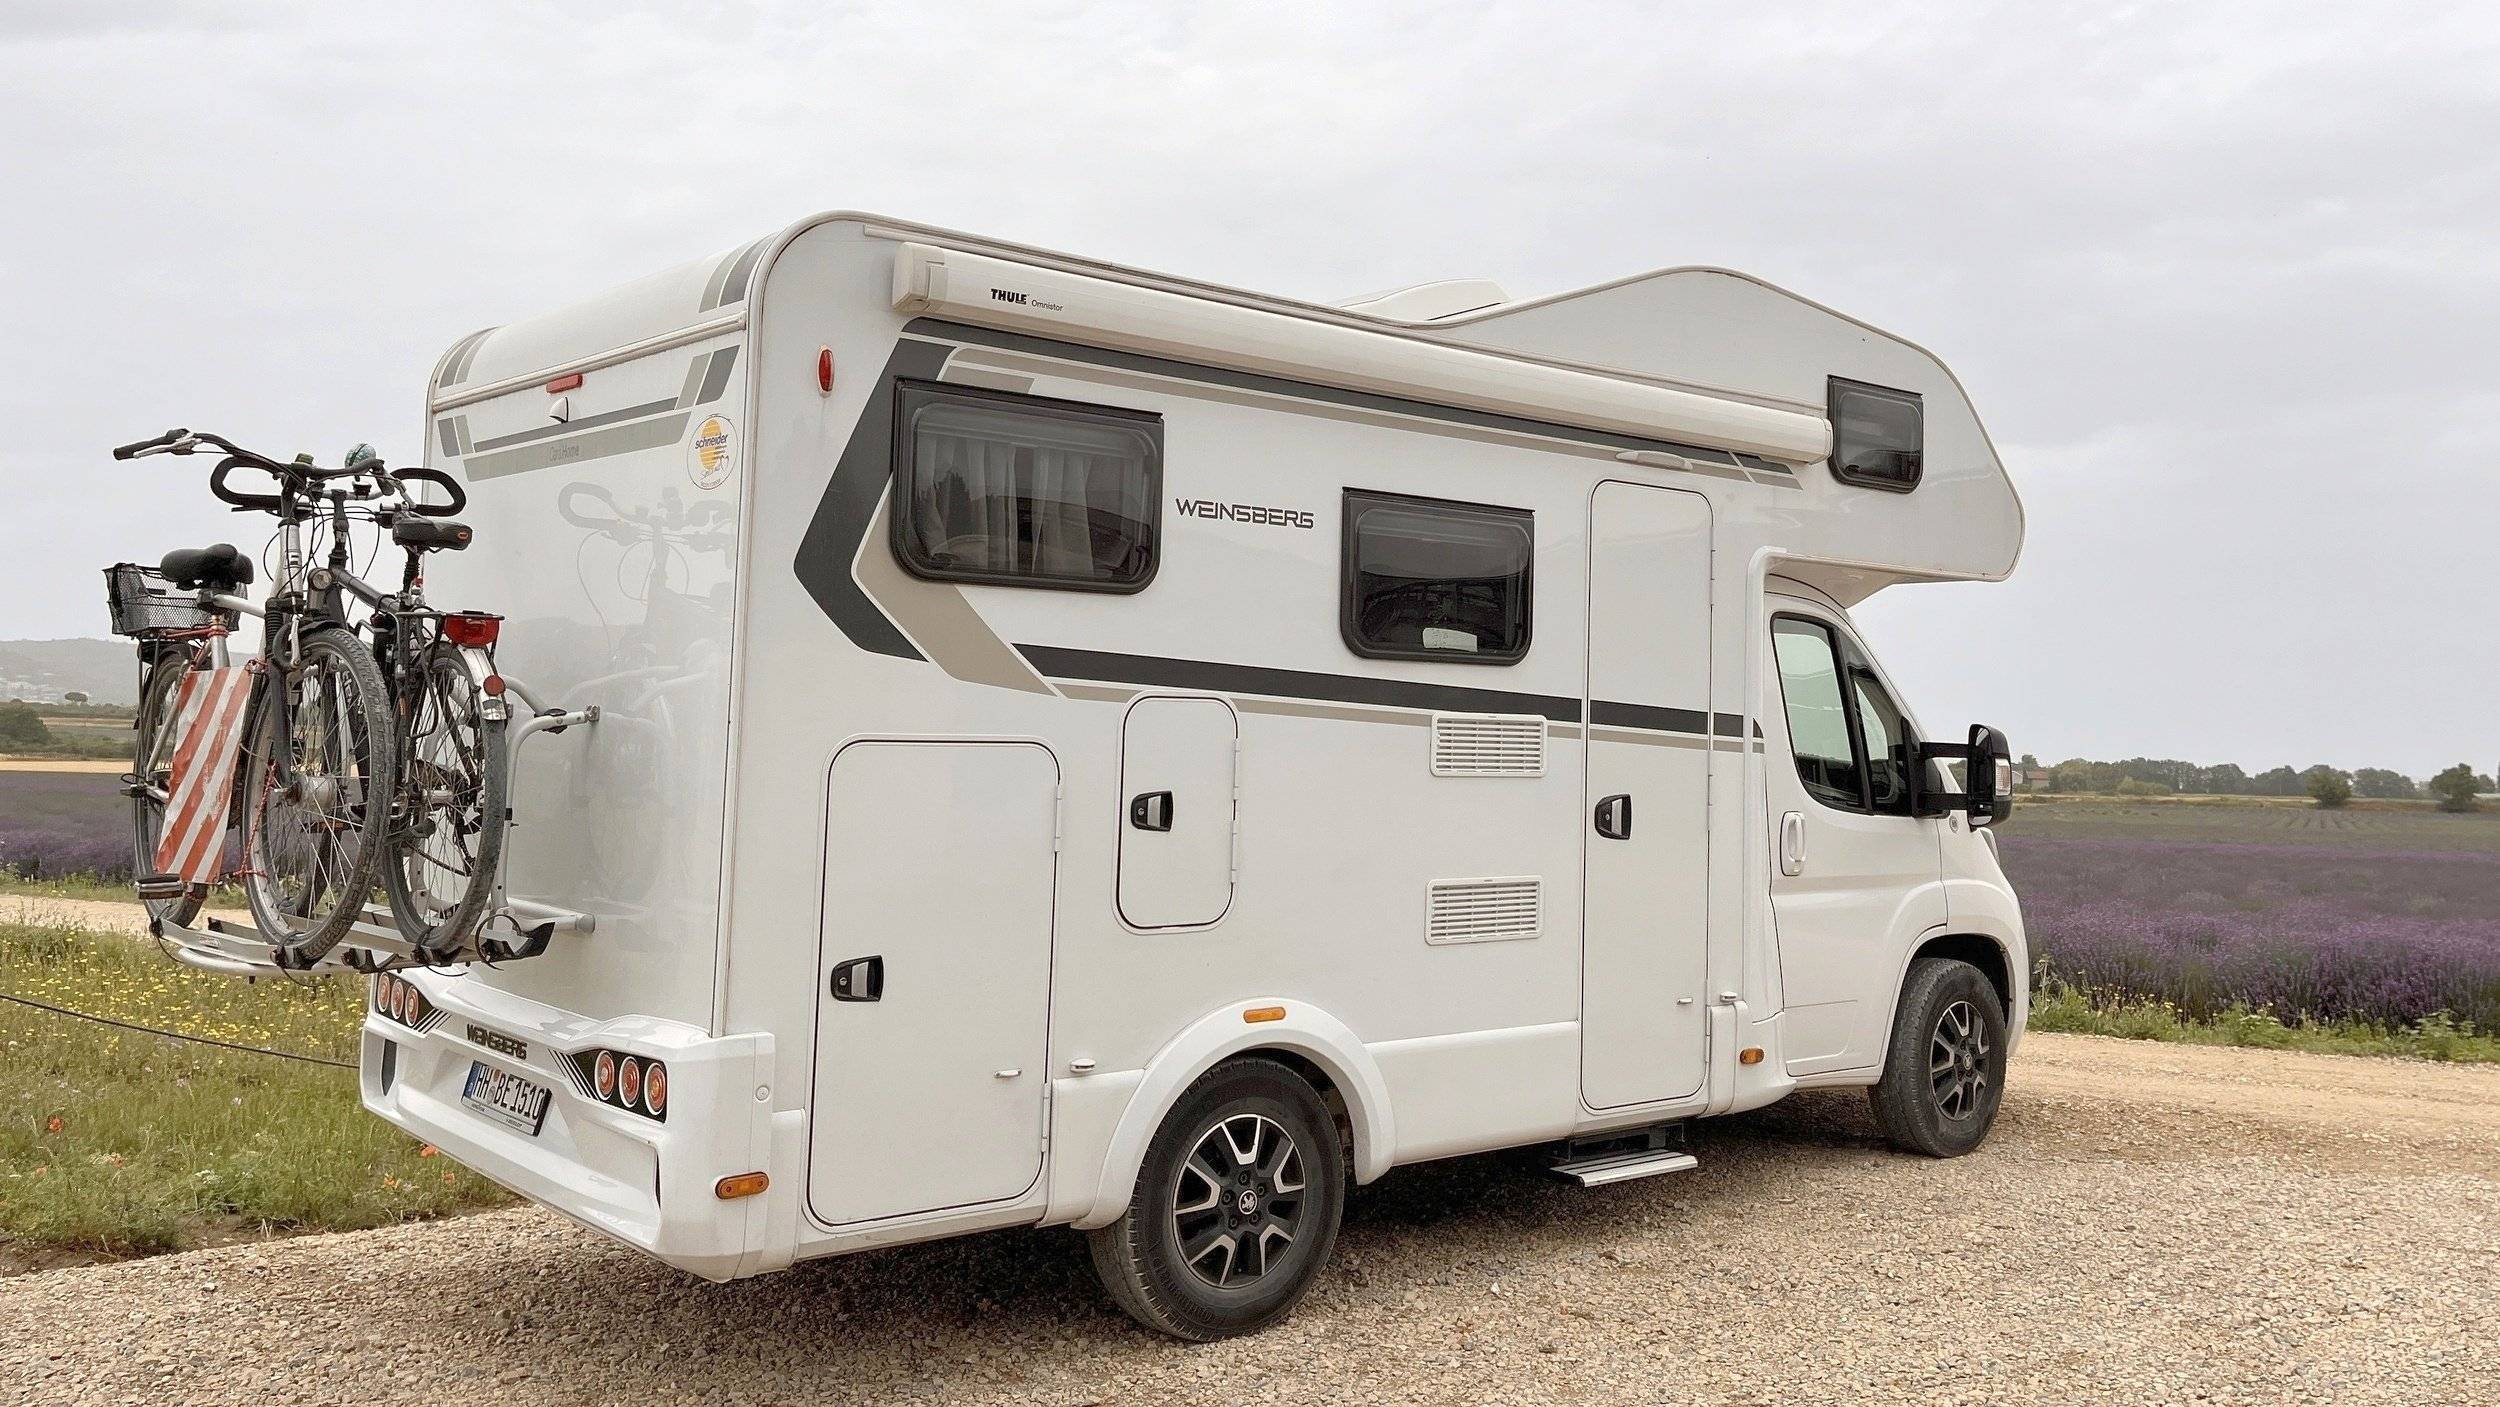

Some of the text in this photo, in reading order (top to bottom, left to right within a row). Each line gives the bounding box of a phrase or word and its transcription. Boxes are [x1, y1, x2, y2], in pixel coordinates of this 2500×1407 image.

[990, 288, 1063, 312] THULE Omnistor
[694, 433, 728, 449] schneider
[1175, 498, 1314, 529] WEINSBERG
[466, 1023, 527, 1060] WEINSBERG
[473, 1065, 494, 1100] HH
[493, 1072, 514, 1108] BE
